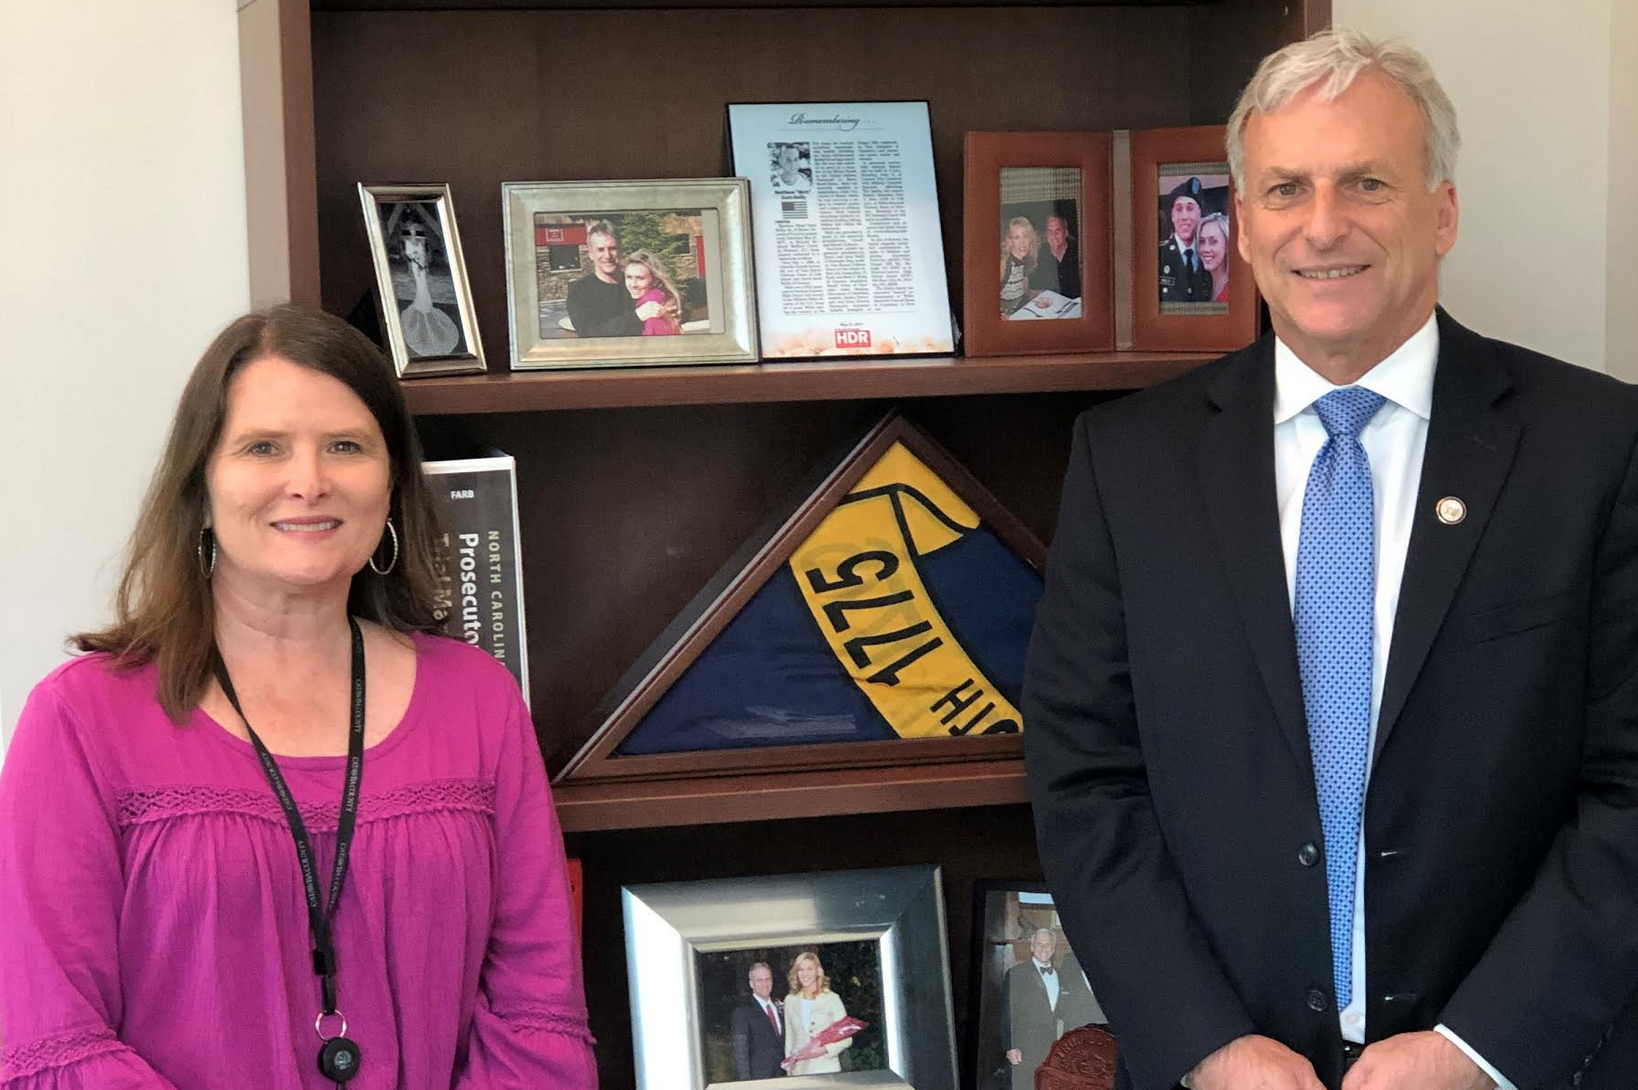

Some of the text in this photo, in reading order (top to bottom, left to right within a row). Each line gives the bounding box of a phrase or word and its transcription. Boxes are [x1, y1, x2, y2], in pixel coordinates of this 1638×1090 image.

[836, 331, 868, 344] HDR
[450, 490, 475, 499] FARB
[459, 533, 481, 648] Prosecuto
[488, 530, 506, 666] NORTH CAROLIN
[805, 550, 943, 687] 1775
